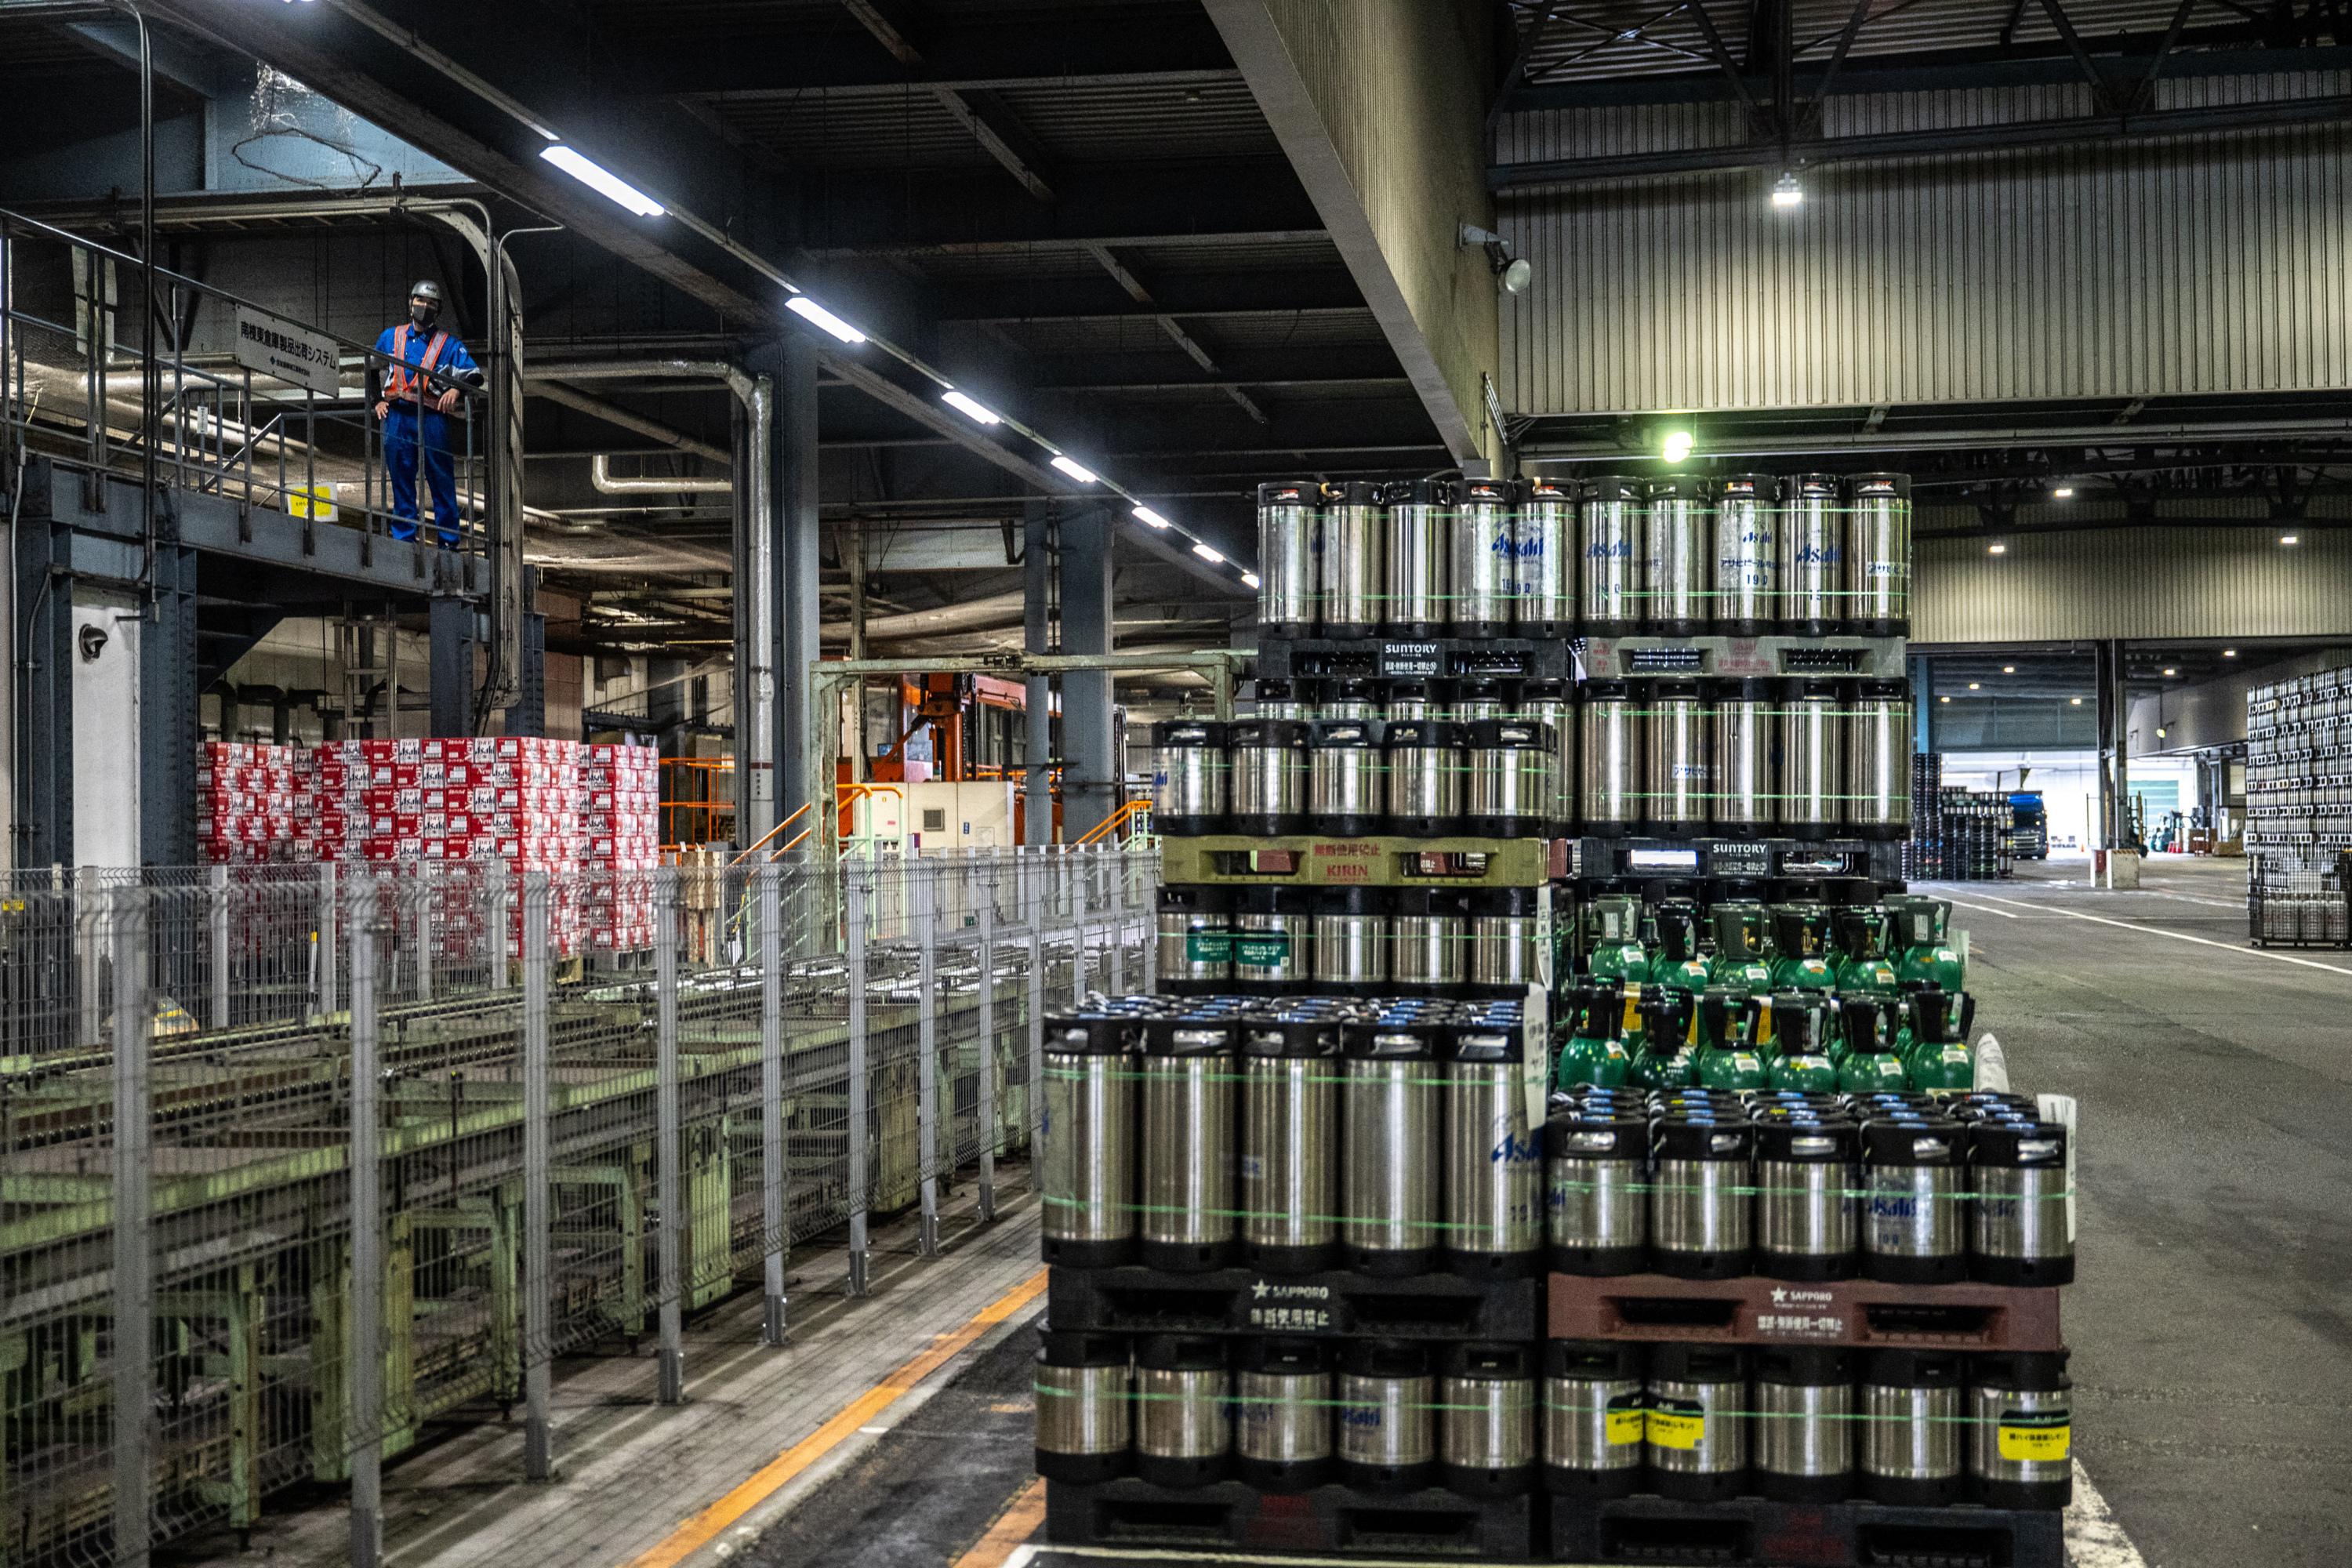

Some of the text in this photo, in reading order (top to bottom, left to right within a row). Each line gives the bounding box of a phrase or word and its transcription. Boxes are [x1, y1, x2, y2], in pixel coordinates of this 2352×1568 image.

[241, 320, 336, 370] 南棟東倉庫製品出荷システム
[1385, 644, 1436, 654] SUNTORY
[1713, 844, 1766, 854] SUNTORY
[1327, 865, 1368, 876] KIRIN
[1272, 1286, 1329, 1300] SAPPORO
[1790, 1290, 1832, 1301] SAPPORO
[1250, 1307, 1329, 1326] 無断使用禁止
